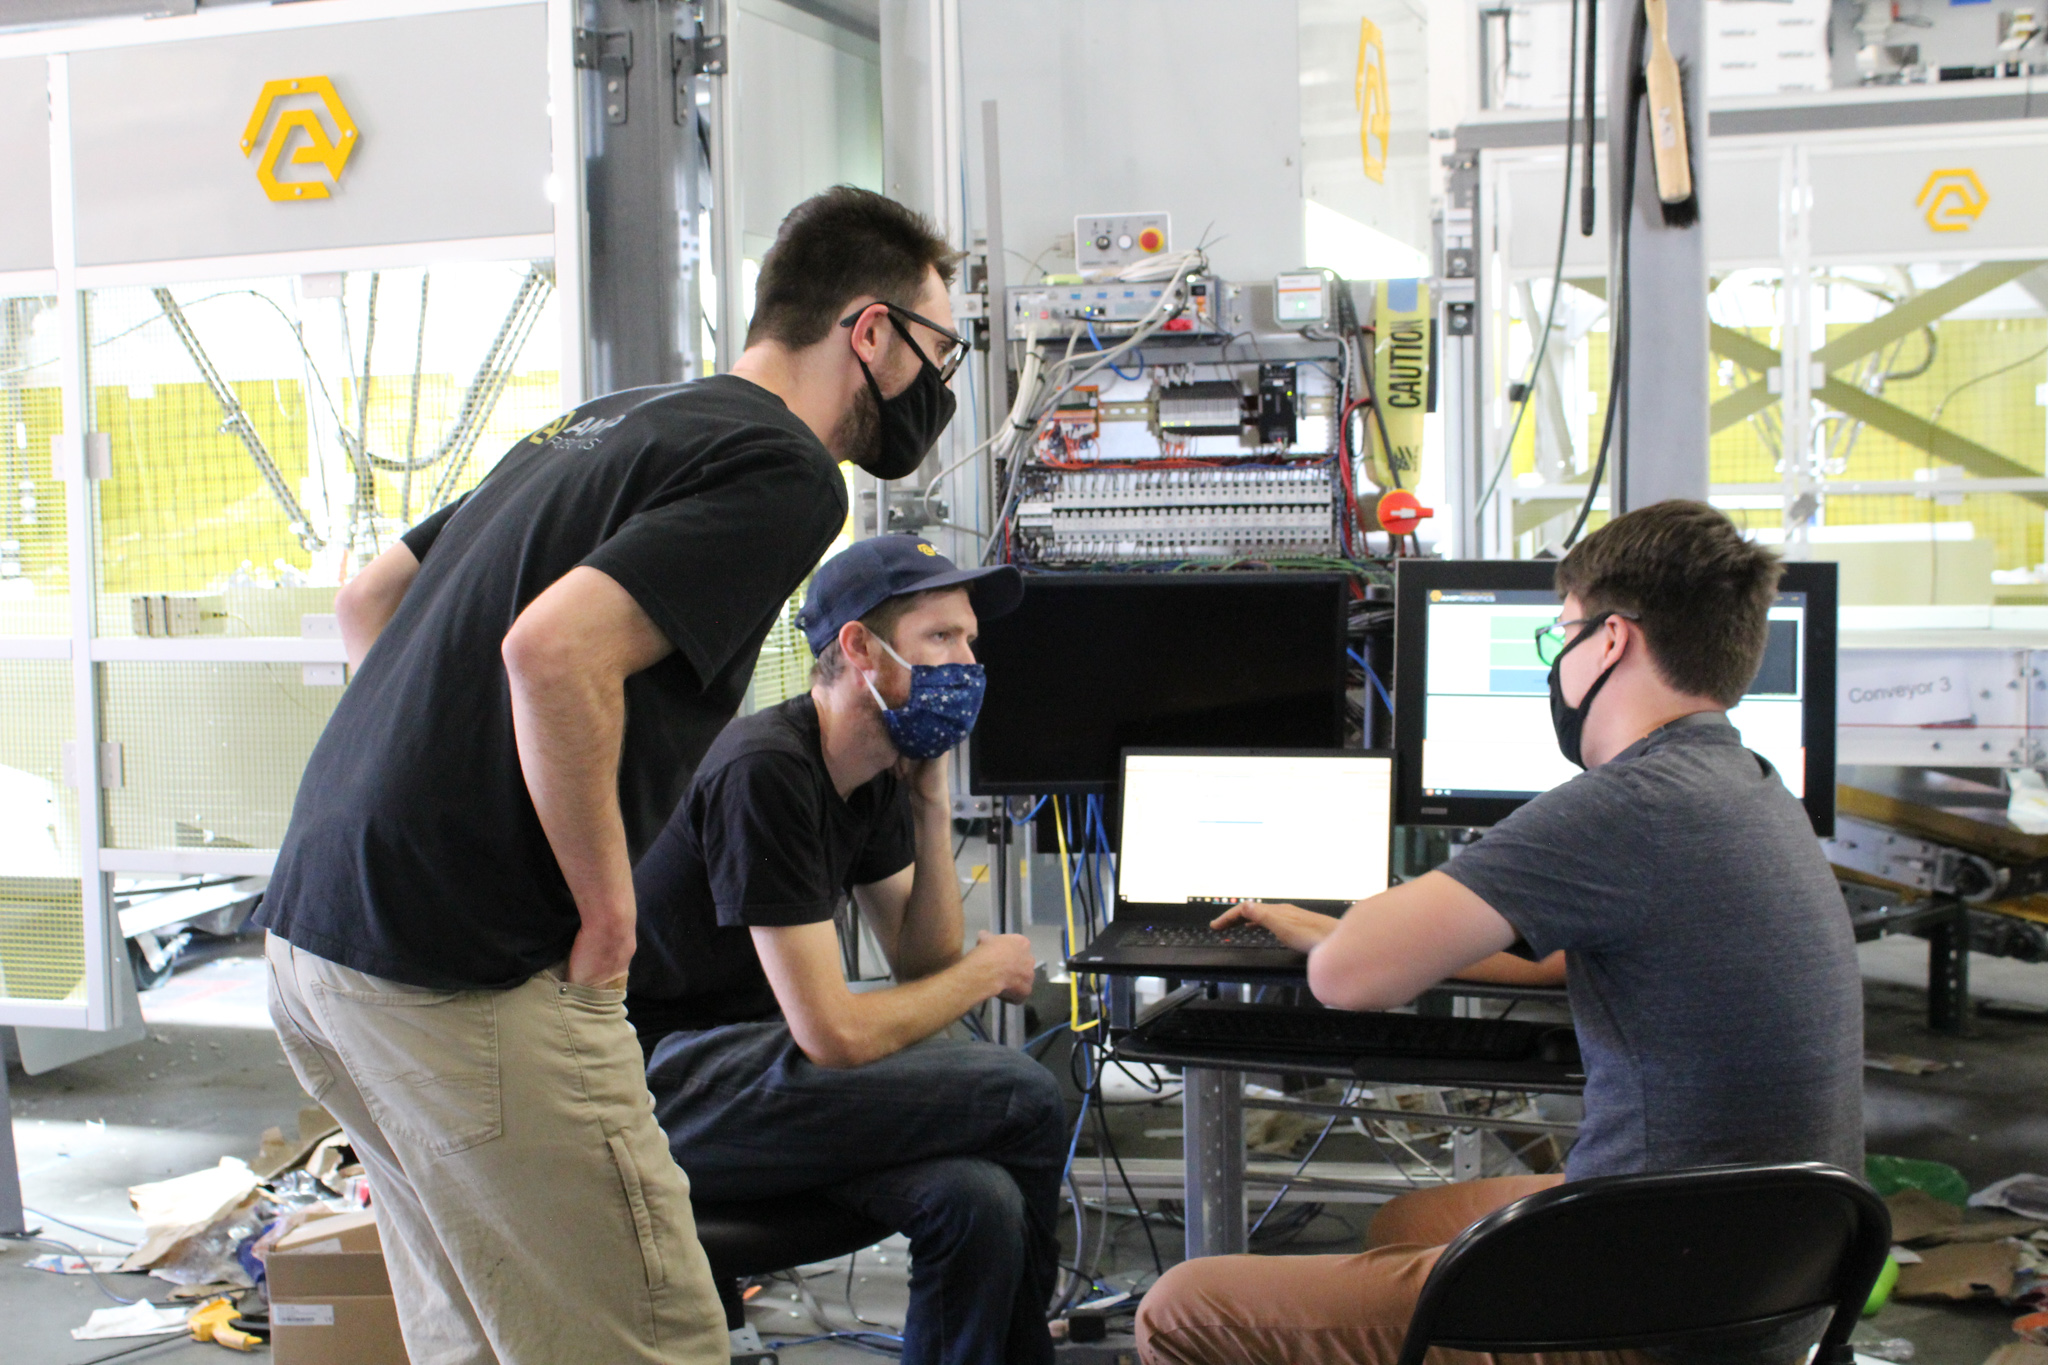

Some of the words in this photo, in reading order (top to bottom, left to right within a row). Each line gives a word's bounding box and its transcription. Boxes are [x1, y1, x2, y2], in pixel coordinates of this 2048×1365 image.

[1388, 319, 1424, 408] CAUTION
[1848, 681, 1934, 704] Conveyor
[1939, 676, 1952, 693] 3
